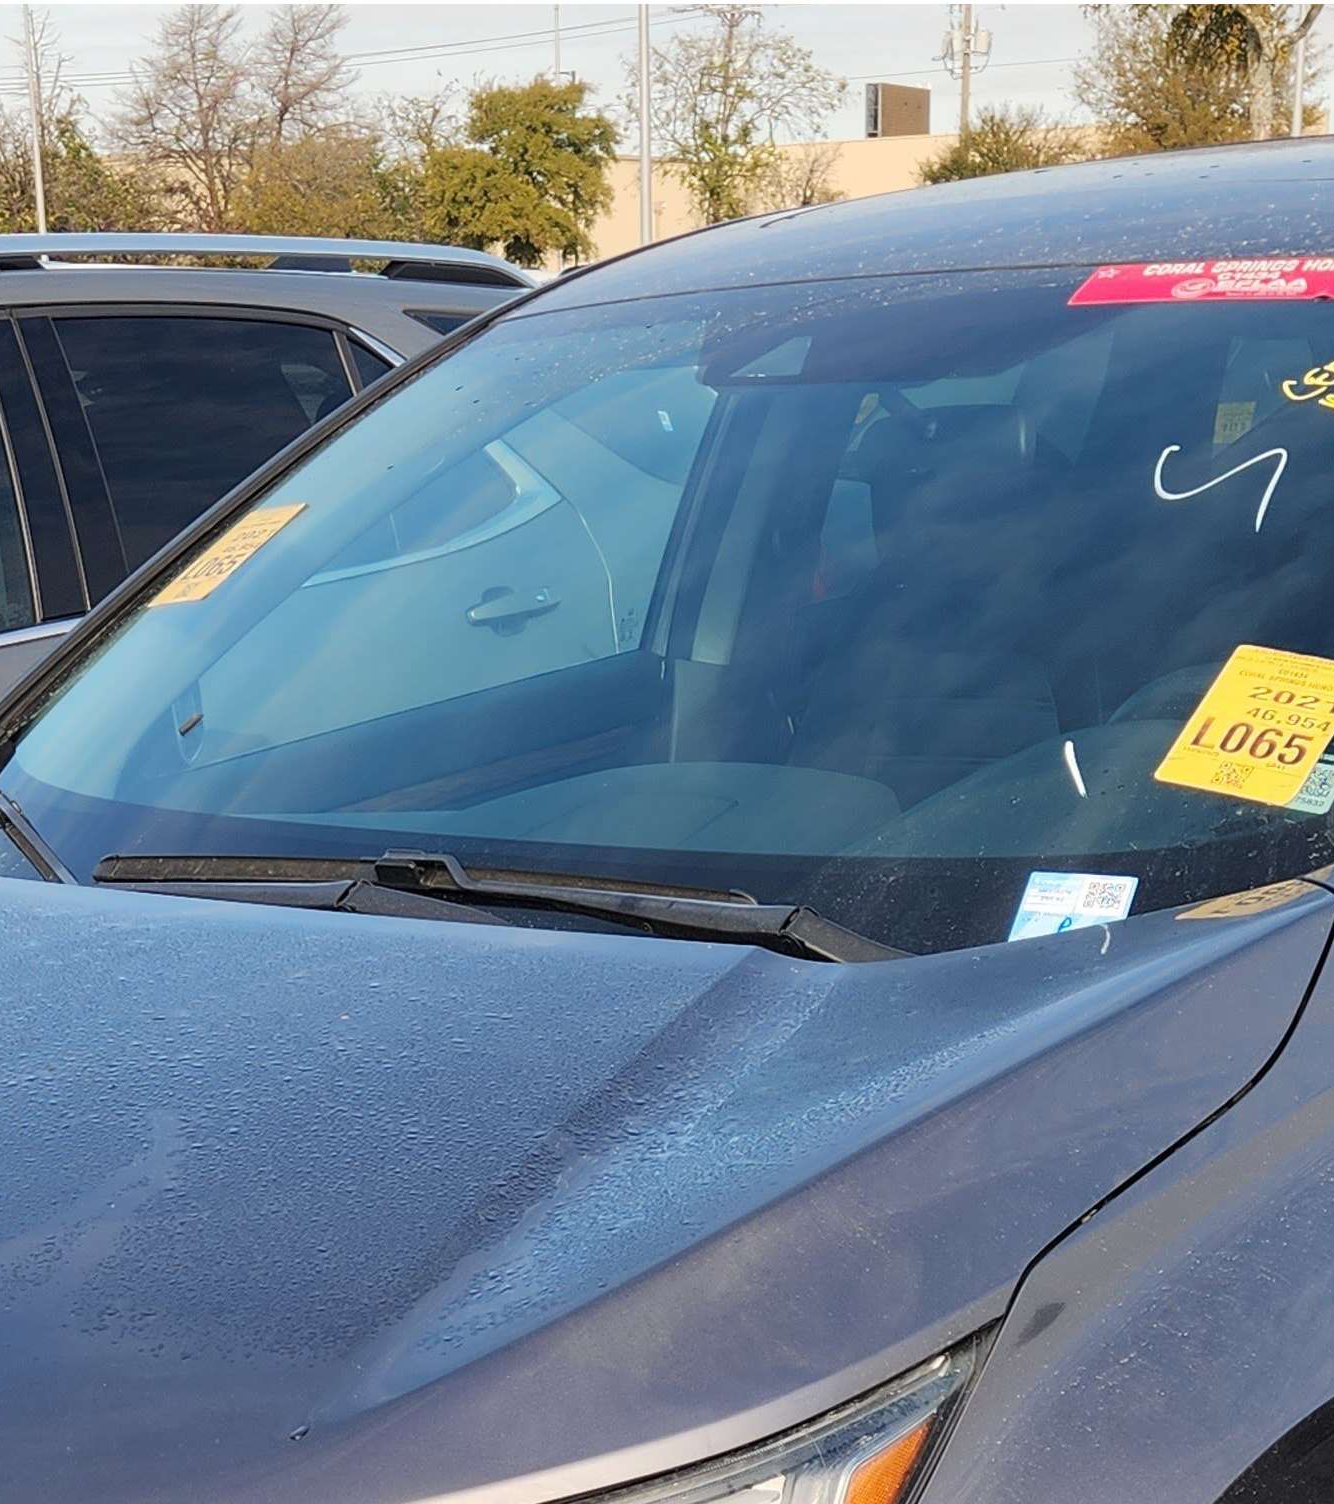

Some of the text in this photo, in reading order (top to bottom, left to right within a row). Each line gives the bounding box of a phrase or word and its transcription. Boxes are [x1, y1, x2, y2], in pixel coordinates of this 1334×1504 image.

[1143, 262, 1206, 276] CORAL
[1210, 259, 1300, 273] SPRINGS
[1189, 716, 1314, 765] L065
